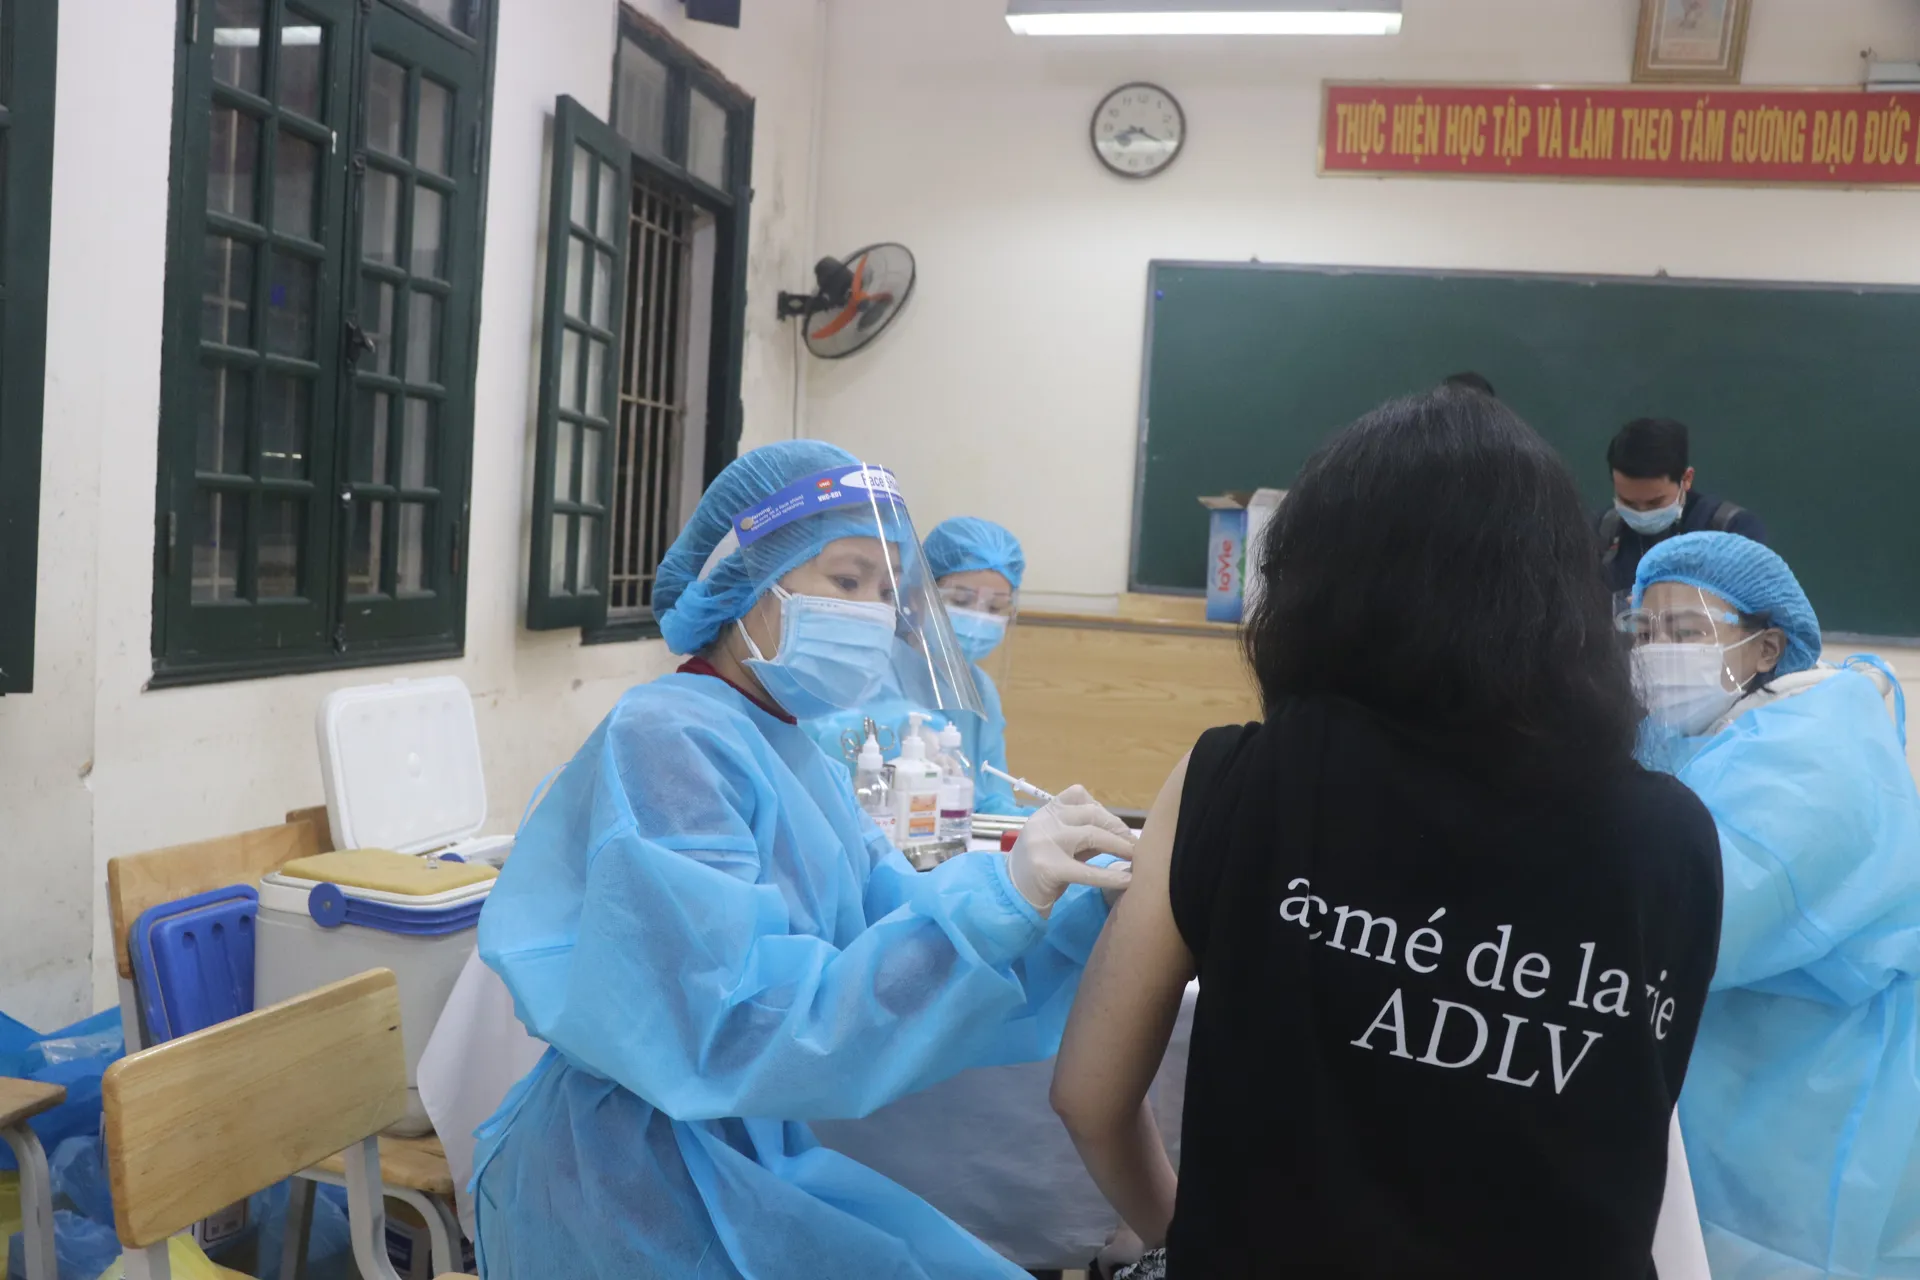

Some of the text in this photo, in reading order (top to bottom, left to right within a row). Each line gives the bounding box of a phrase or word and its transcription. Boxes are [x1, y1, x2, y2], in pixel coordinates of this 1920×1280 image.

[1336, 100, 1387, 164] THỰC
[1391, 94, 1442, 164] HIỆN
[1444, 104, 1487, 165] HỌC
[1493, 95, 1532, 166] TẬP
[1537, 97, 1563, 158] VÀ
[1569, 97, 1616, 160] LÀM
[1621, 108, 1674, 161] THEO
[1680, 95, 1726, 163] TẤM
[1731, 104, 1807, 163] GƯƠNG
[1811, 109, 1859, 174] ĐẠO
[1863, 96, 1912, 165] ĐỨC
[1467, 925, 1551, 999] de
[1568, 941, 1630, 1018] la
[1350, 989, 1604, 1095] ADLV
